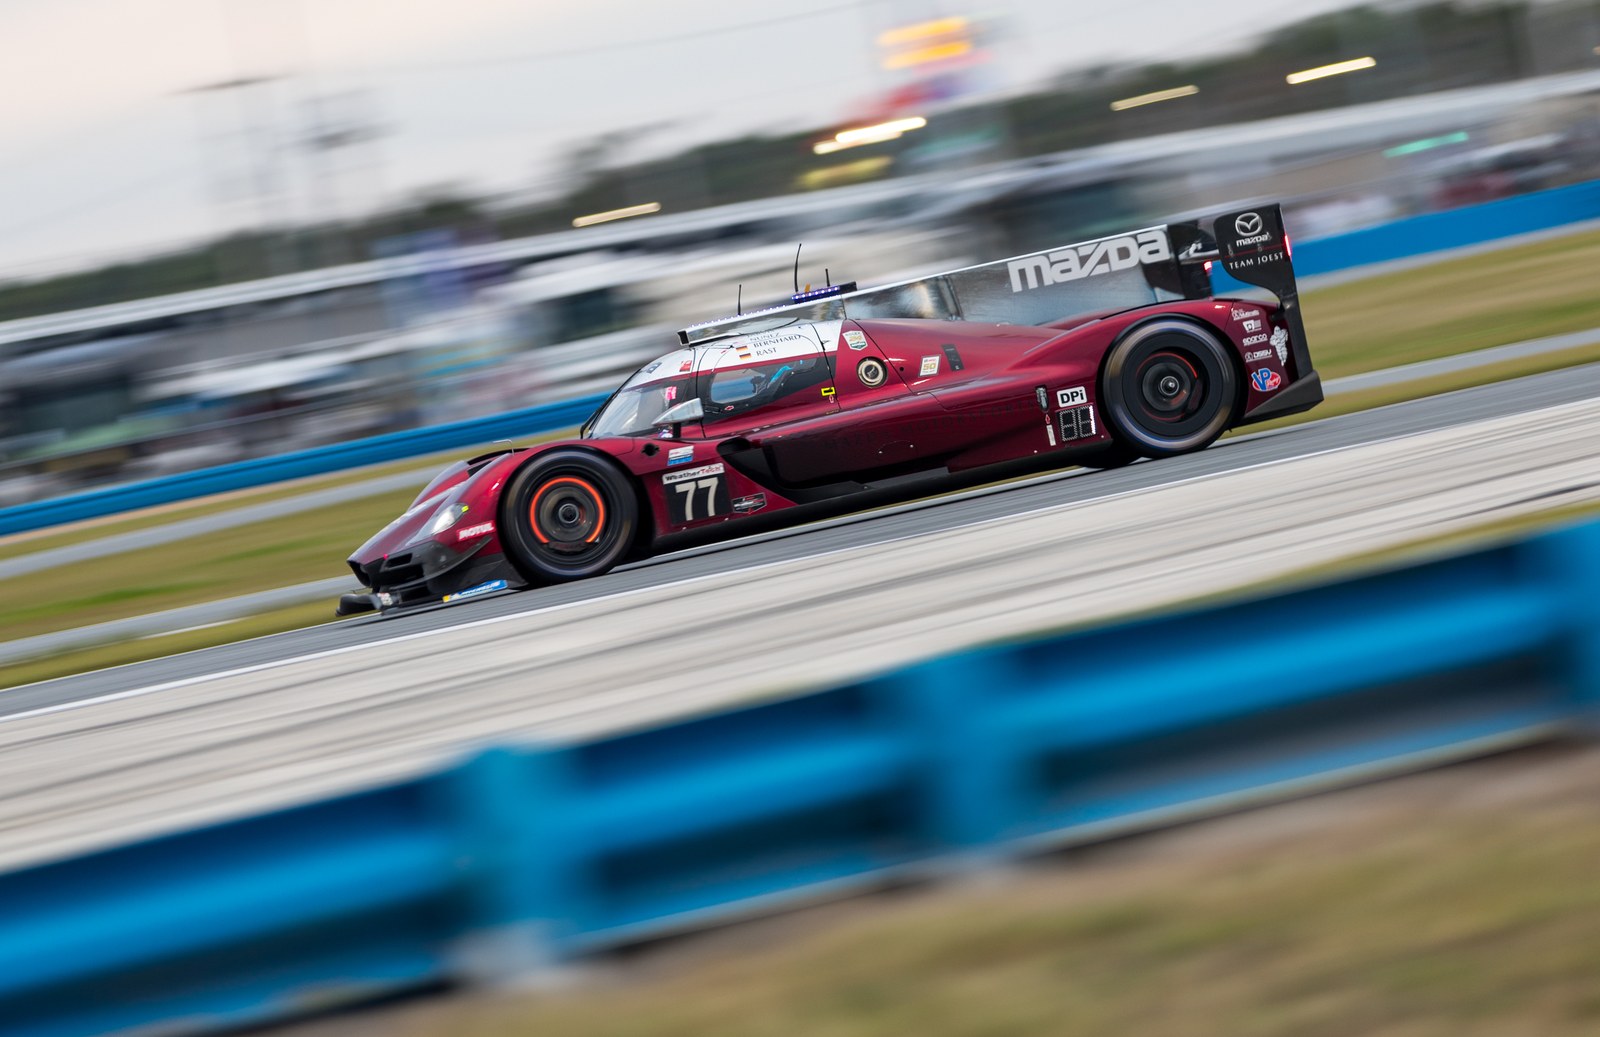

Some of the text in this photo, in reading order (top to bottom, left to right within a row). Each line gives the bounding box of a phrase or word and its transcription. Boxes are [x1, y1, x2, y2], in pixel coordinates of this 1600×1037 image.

[1228, 251, 1283, 270] TEAM JOEST
[753, 335, 801, 348] BERNHARD
[756, 347, 777, 357] RAST
[1251, 368, 1272, 391] VP
[1060, 389, 1085, 404] DPi
[675, 477, 719, 522] 77
[459, 522, 494, 540] MOTUL
